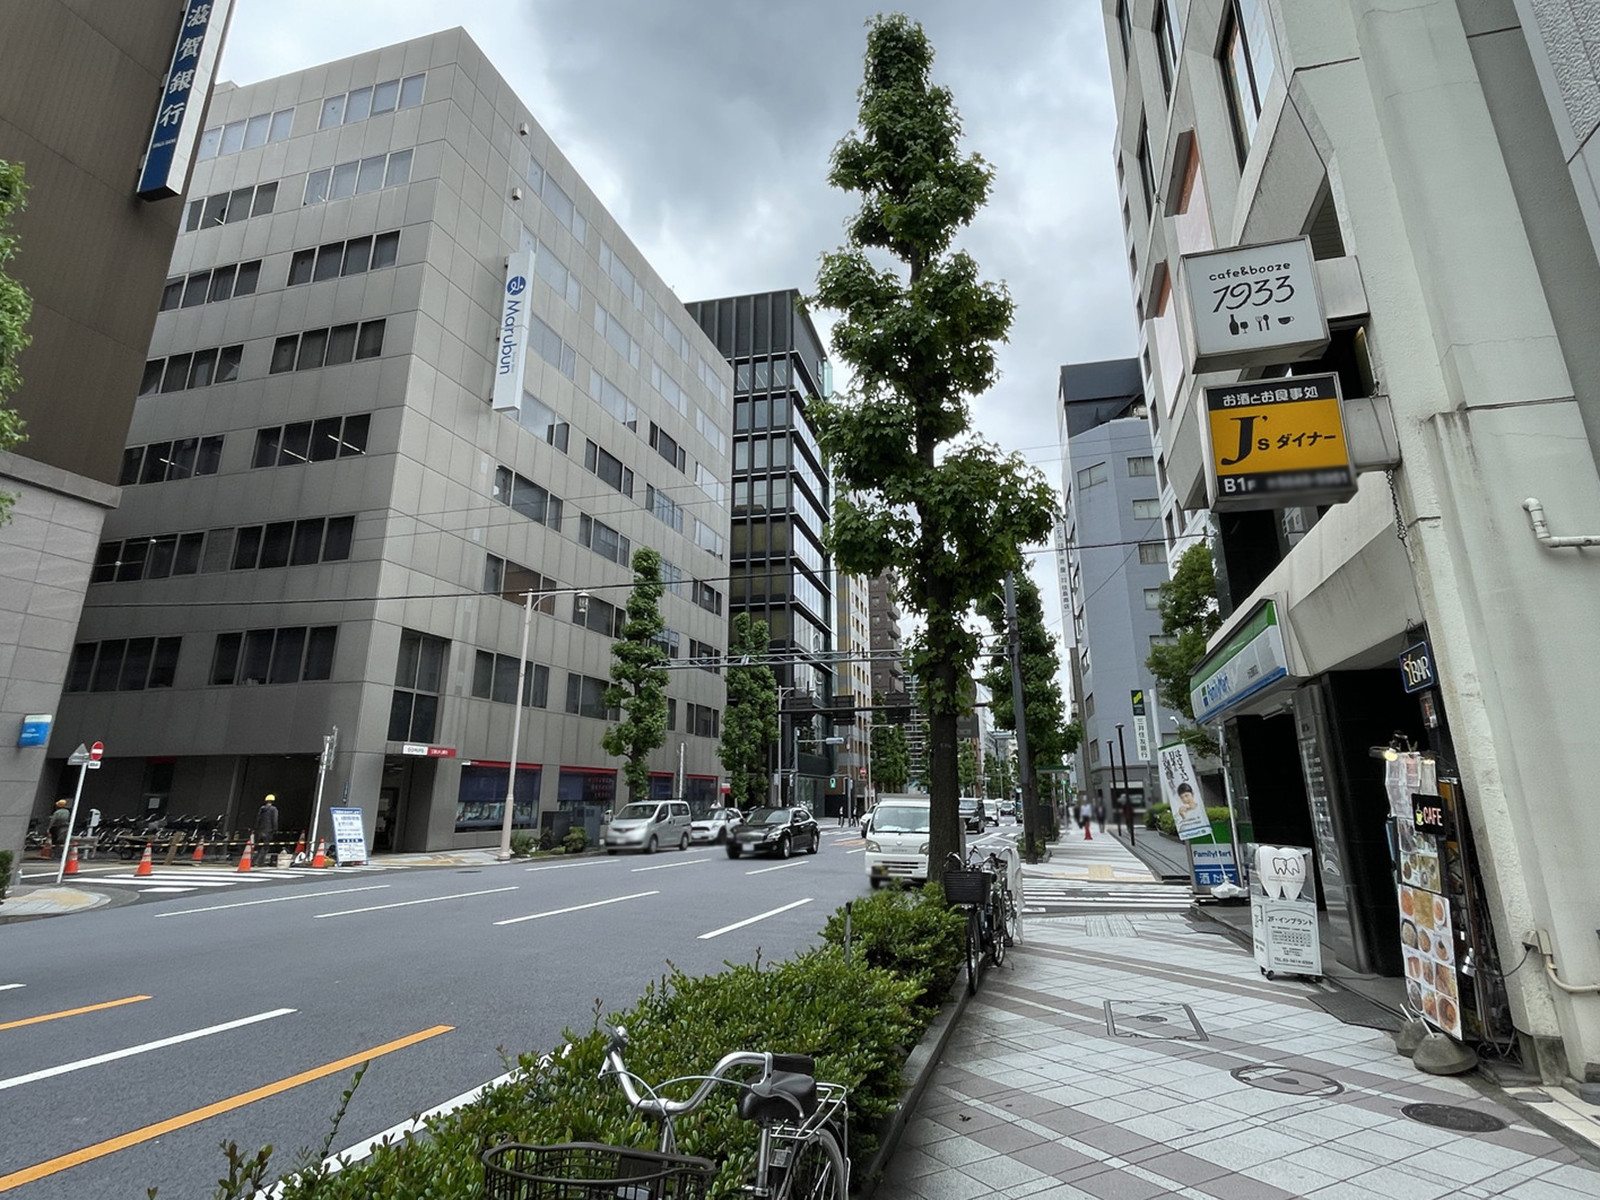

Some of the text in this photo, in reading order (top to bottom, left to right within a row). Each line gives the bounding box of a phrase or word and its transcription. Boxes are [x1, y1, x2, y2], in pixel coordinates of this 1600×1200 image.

[160, 4, 210, 128] 滋賀銀行
[1209, 262, 1291, 281] cafe&booze
[499, 299, 522, 375] Marubun
[1222, 386, 1319, 407] お酒とお食事処
[1276, 431, 1337, 449] ダイナー
[1411, 655, 1430, 684] BAR
[1423, 806, 1443, 827] CAFE
[1199, 872, 1211, 884] 酒
